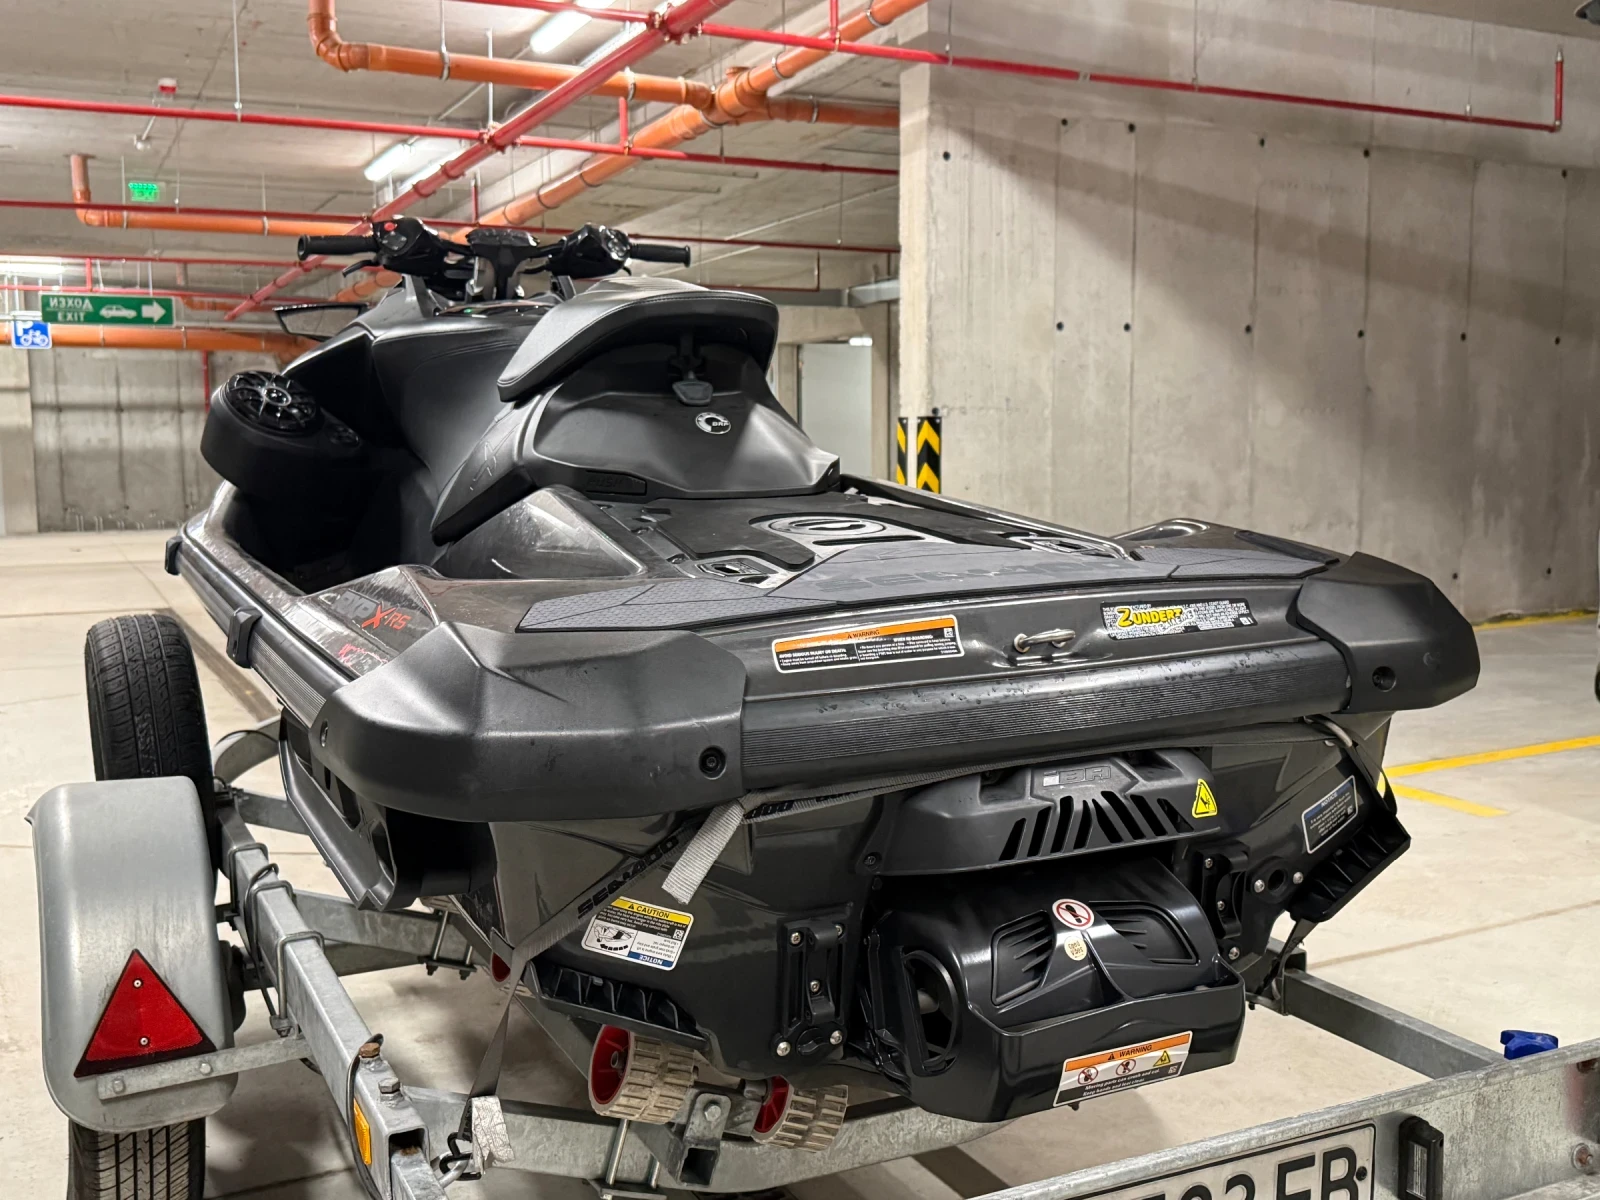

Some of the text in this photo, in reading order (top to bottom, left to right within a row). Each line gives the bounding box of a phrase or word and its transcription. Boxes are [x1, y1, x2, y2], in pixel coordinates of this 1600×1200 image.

[57, 312, 86, 322] EXIT
[853, 629, 880, 639] WARNING
[1320, 792, 1338, 808] NOTICE
[636, 905, 670, 919] CAUTION
[639, 954, 664, 965] NOTICE
[1119, 1044, 1153, 1058] WARNING
